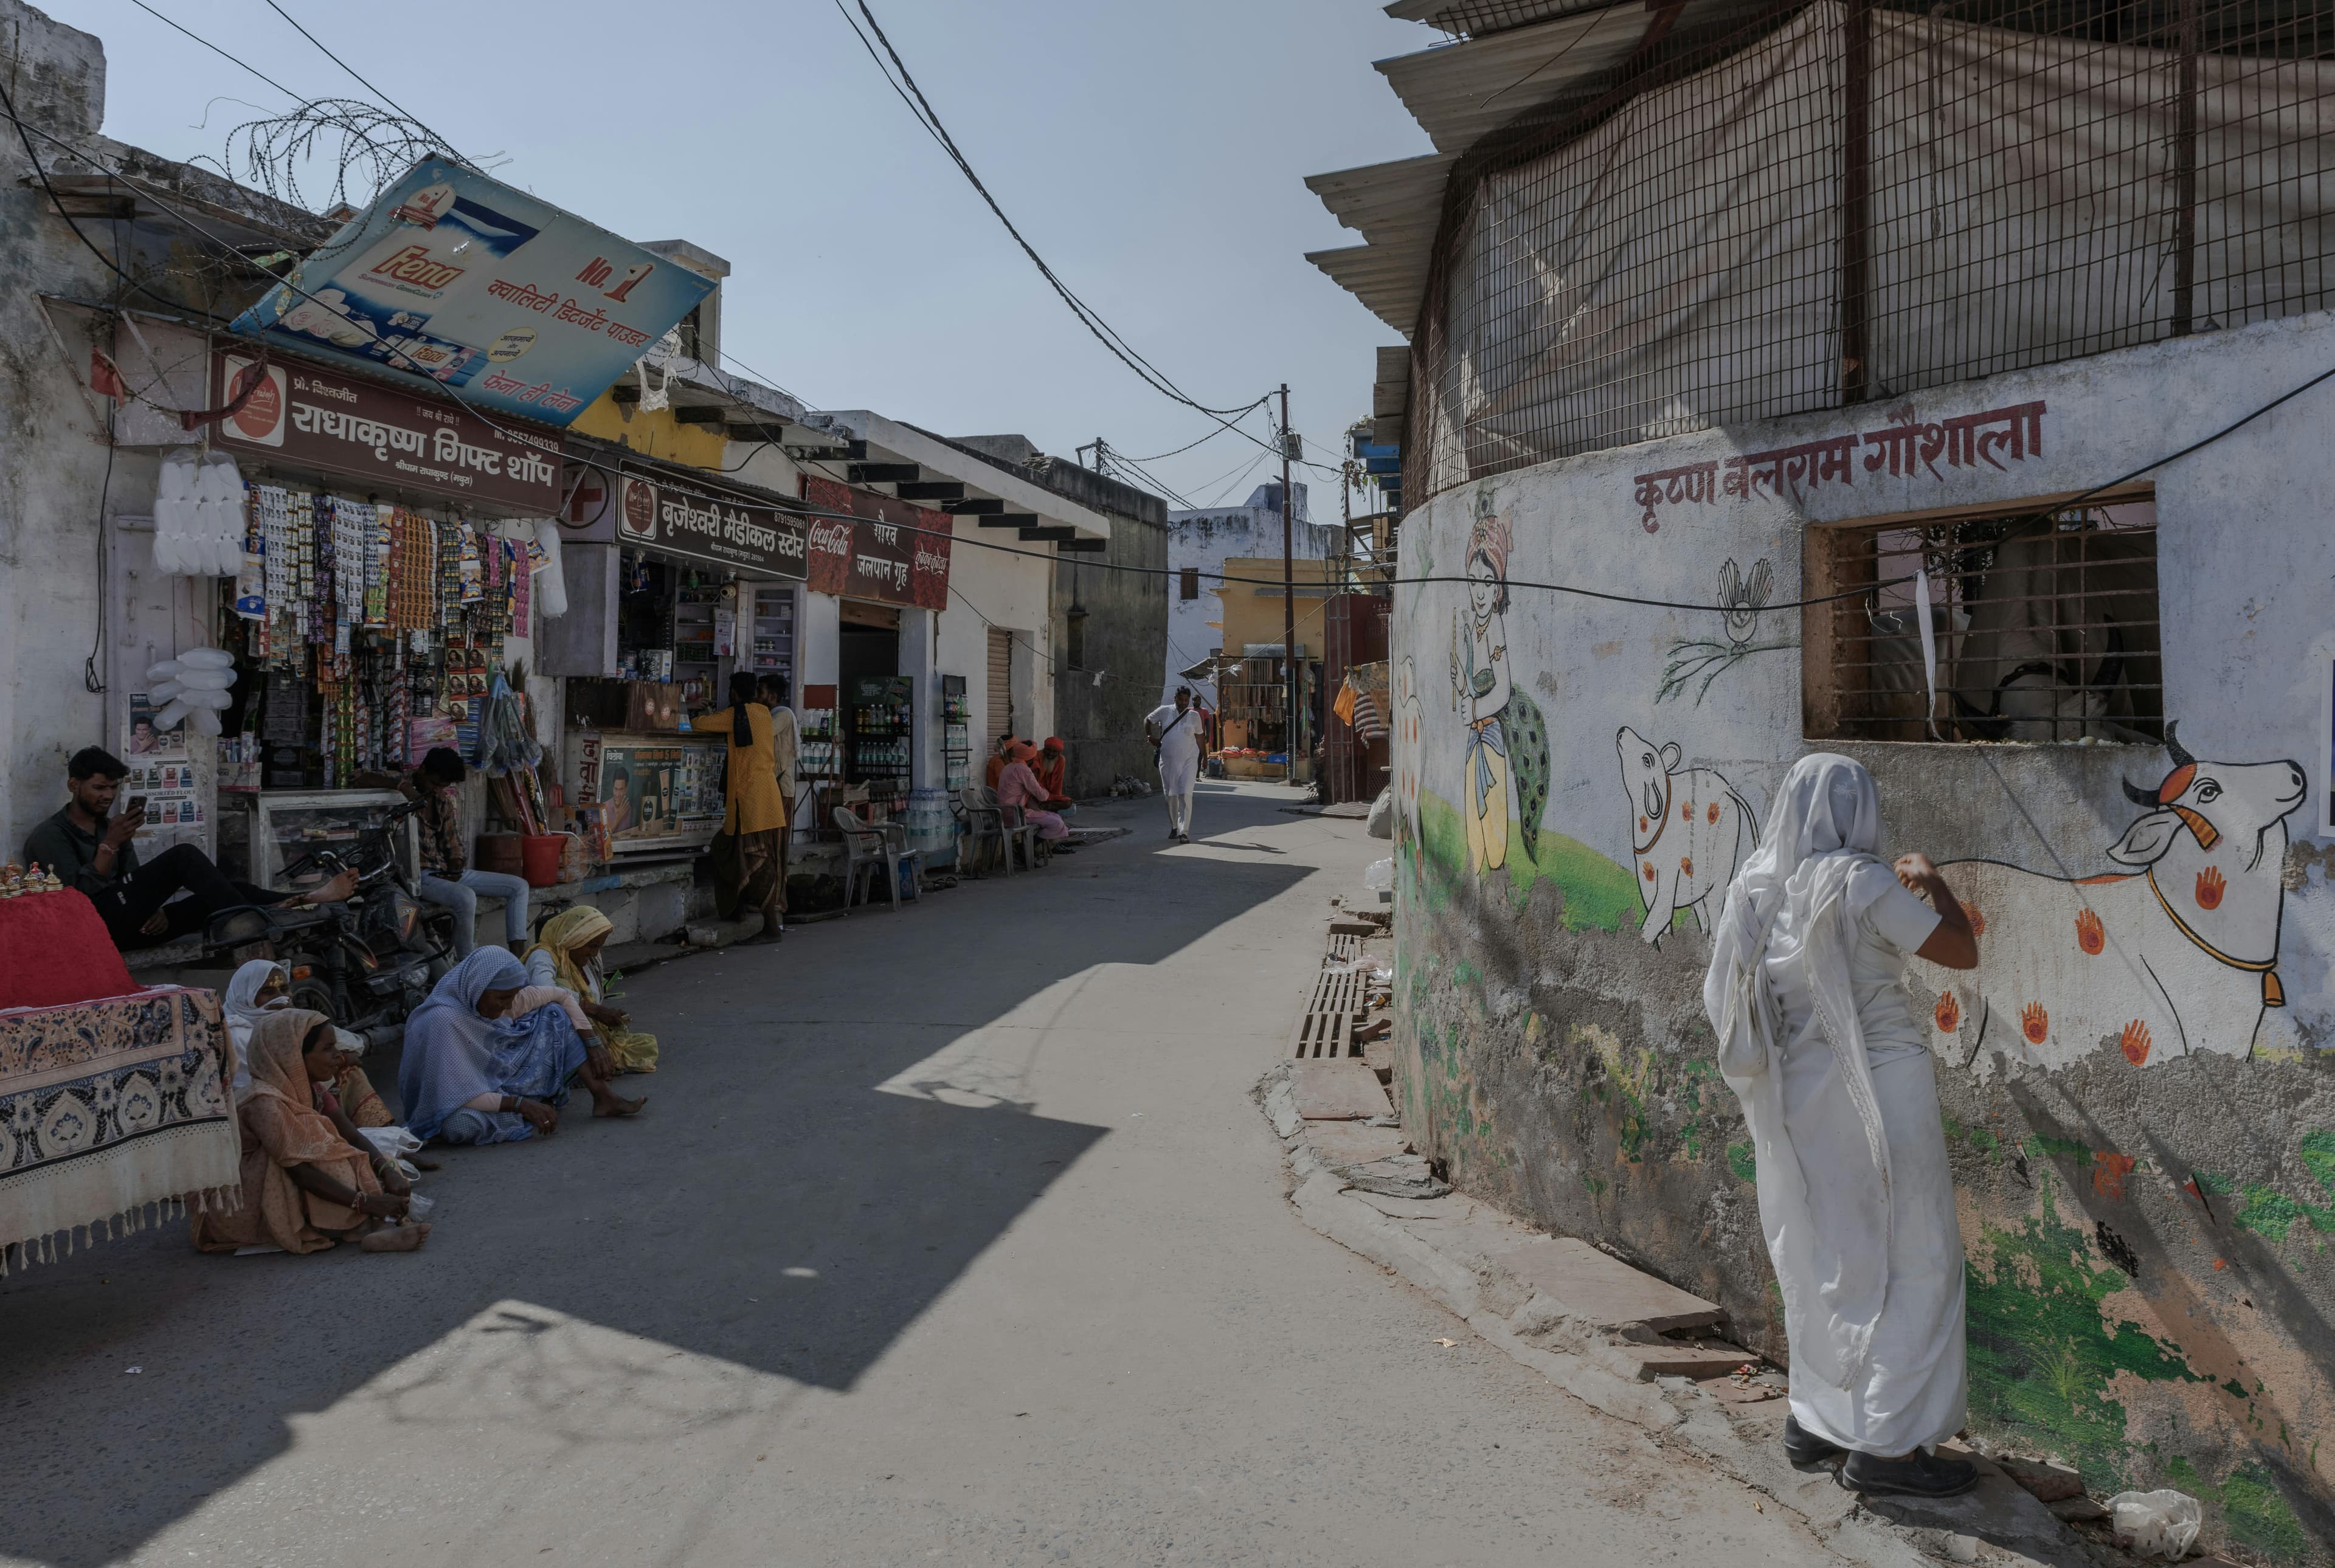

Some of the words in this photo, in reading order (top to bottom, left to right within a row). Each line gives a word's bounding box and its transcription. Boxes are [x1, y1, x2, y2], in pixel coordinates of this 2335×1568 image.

[370, 245, 466, 290] Fena
[575, 256, 613, 289] No.
[603, 263, 654, 303] 1
[487, 279, 559, 314] क्वालिटी
[607, 322, 652, 348] पाउडर
[411, 345, 448, 362] Fena
[292, 376, 309, 390] प्रो.
[483, 370, 526, 395] फेना
[517, 382, 550, 403] ही
[542, 389, 584, 413] लेना
[422, 409, 433, 419] जय
[443, 412, 454, 425] राधे
[292, 401, 427, 462] राधाकृष्ण
[433, 427, 503, 475] गिफ्ट
[506, 451, 555, 487] शॉप
[1634, 460, 1720, 534] कृष्ण
[1863, 399, 2047, 482] गौशाला
[662, 496, 721, 537] बृजेश्वरी
[724, 508, 777, 552] मैडीकल
[778, 527, 804, 559] स्टोर
[774, 511, 805, 530] 8791595061
[857, 554, 892, 582] जलपान
[894, 563, 909, 592] गृह
